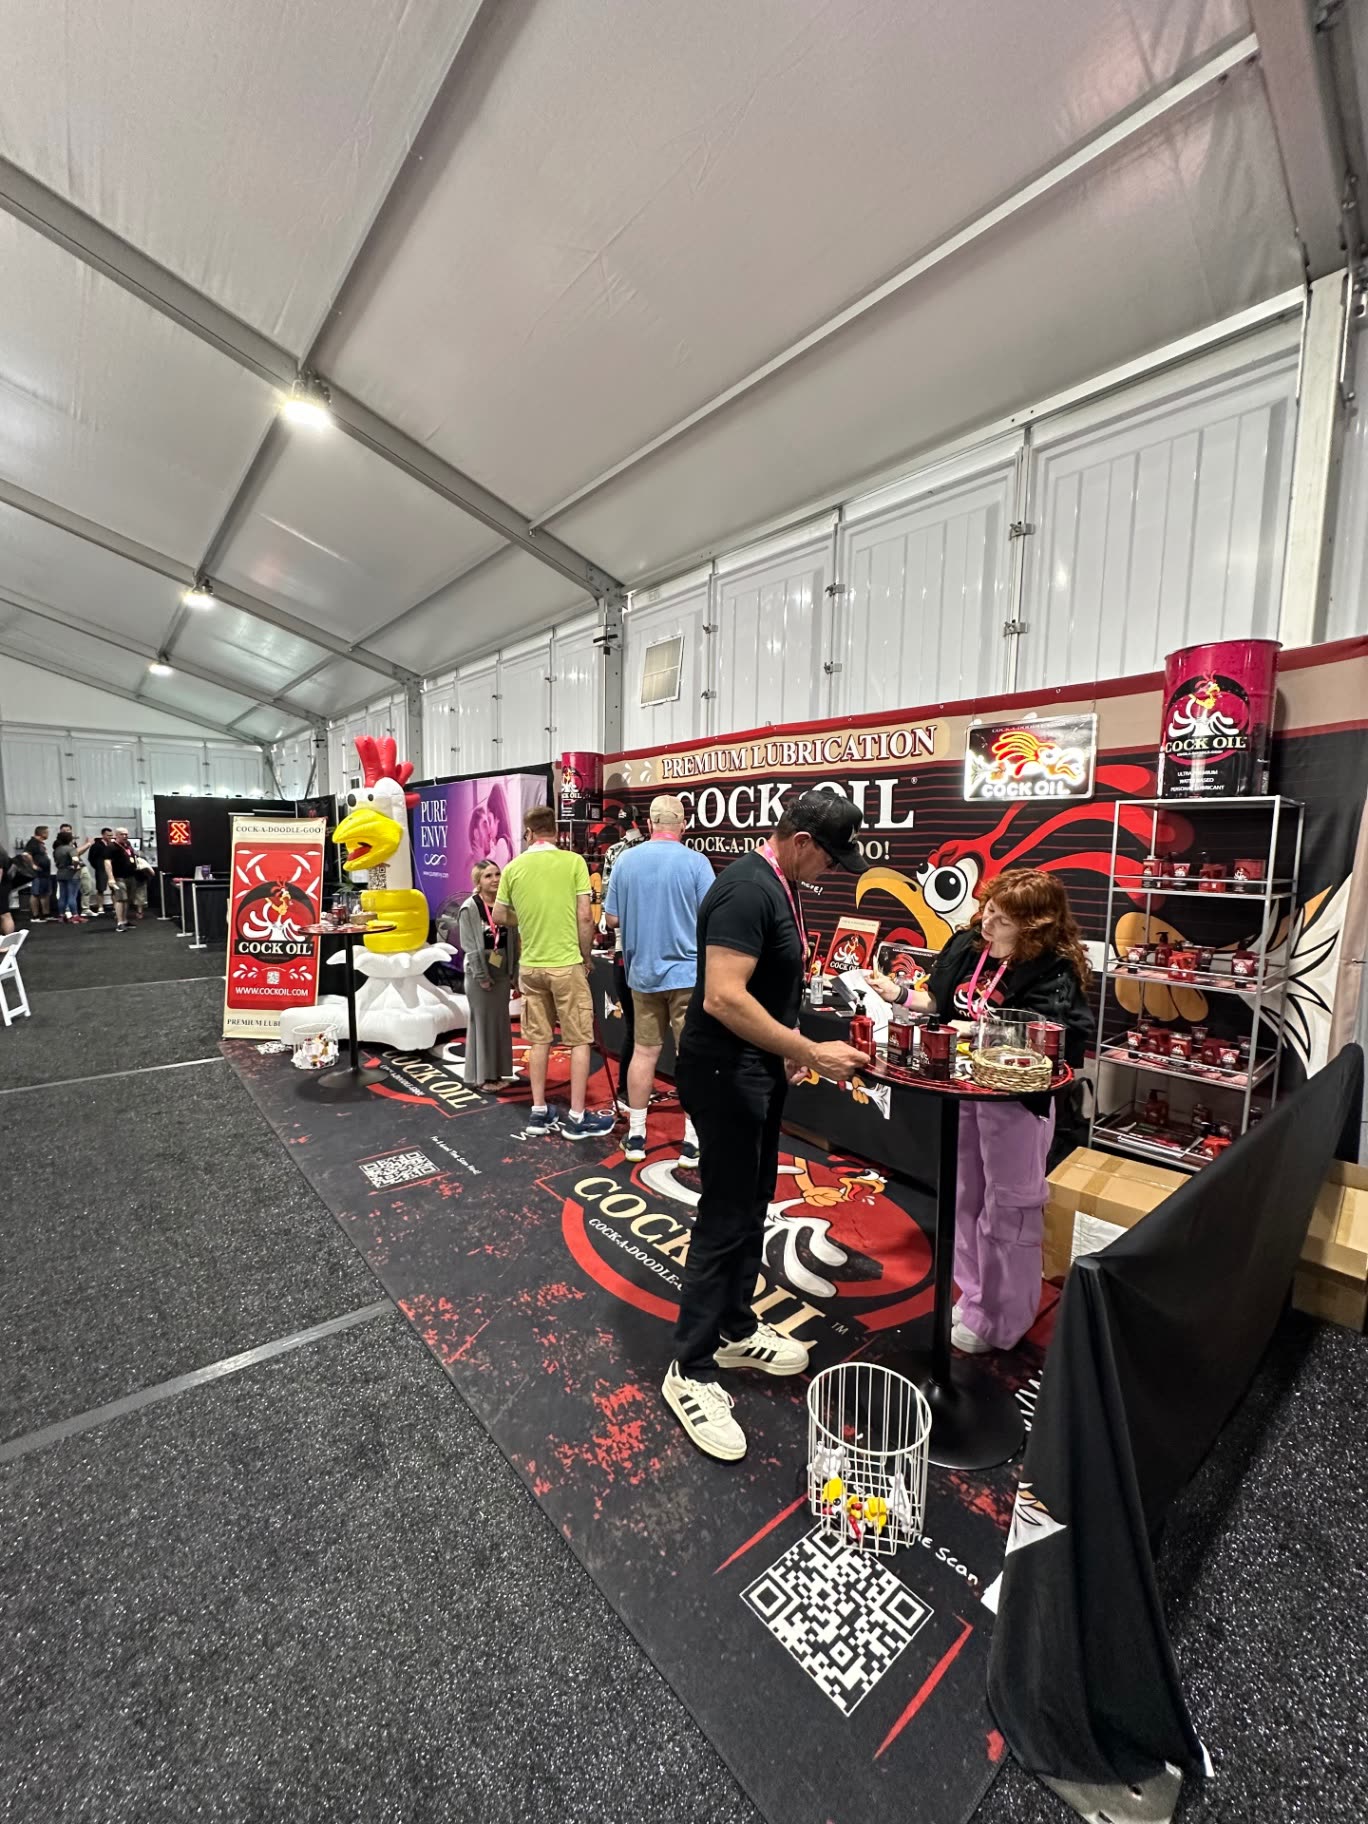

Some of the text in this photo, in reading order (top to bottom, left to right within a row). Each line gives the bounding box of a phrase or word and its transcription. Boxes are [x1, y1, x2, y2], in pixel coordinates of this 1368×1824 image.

[661, 725, 938, 779] PREMIUM LUBRICATION
[1165, 736, 1247, 753] COCK OIL
[981, 779, 1072, 798] COCK OIL
[420, 799, 448, 823] PURE
[676, 782, 792, 829] COCK
[420, 825, 449, 848] ENVY
[238, 941, 312, 955] COCK OIL
[235, 986, 309, 997] WWW.COCKOIL.COM
[227, 1018, 262, 1026] PREMIUM
[382, 1051, 448, 1084] COCK
[429, 1081, 482, 1109] OIL
[574, 1176, 692, 1268] COCK
[935, 1546, 979, 1586] Scan
